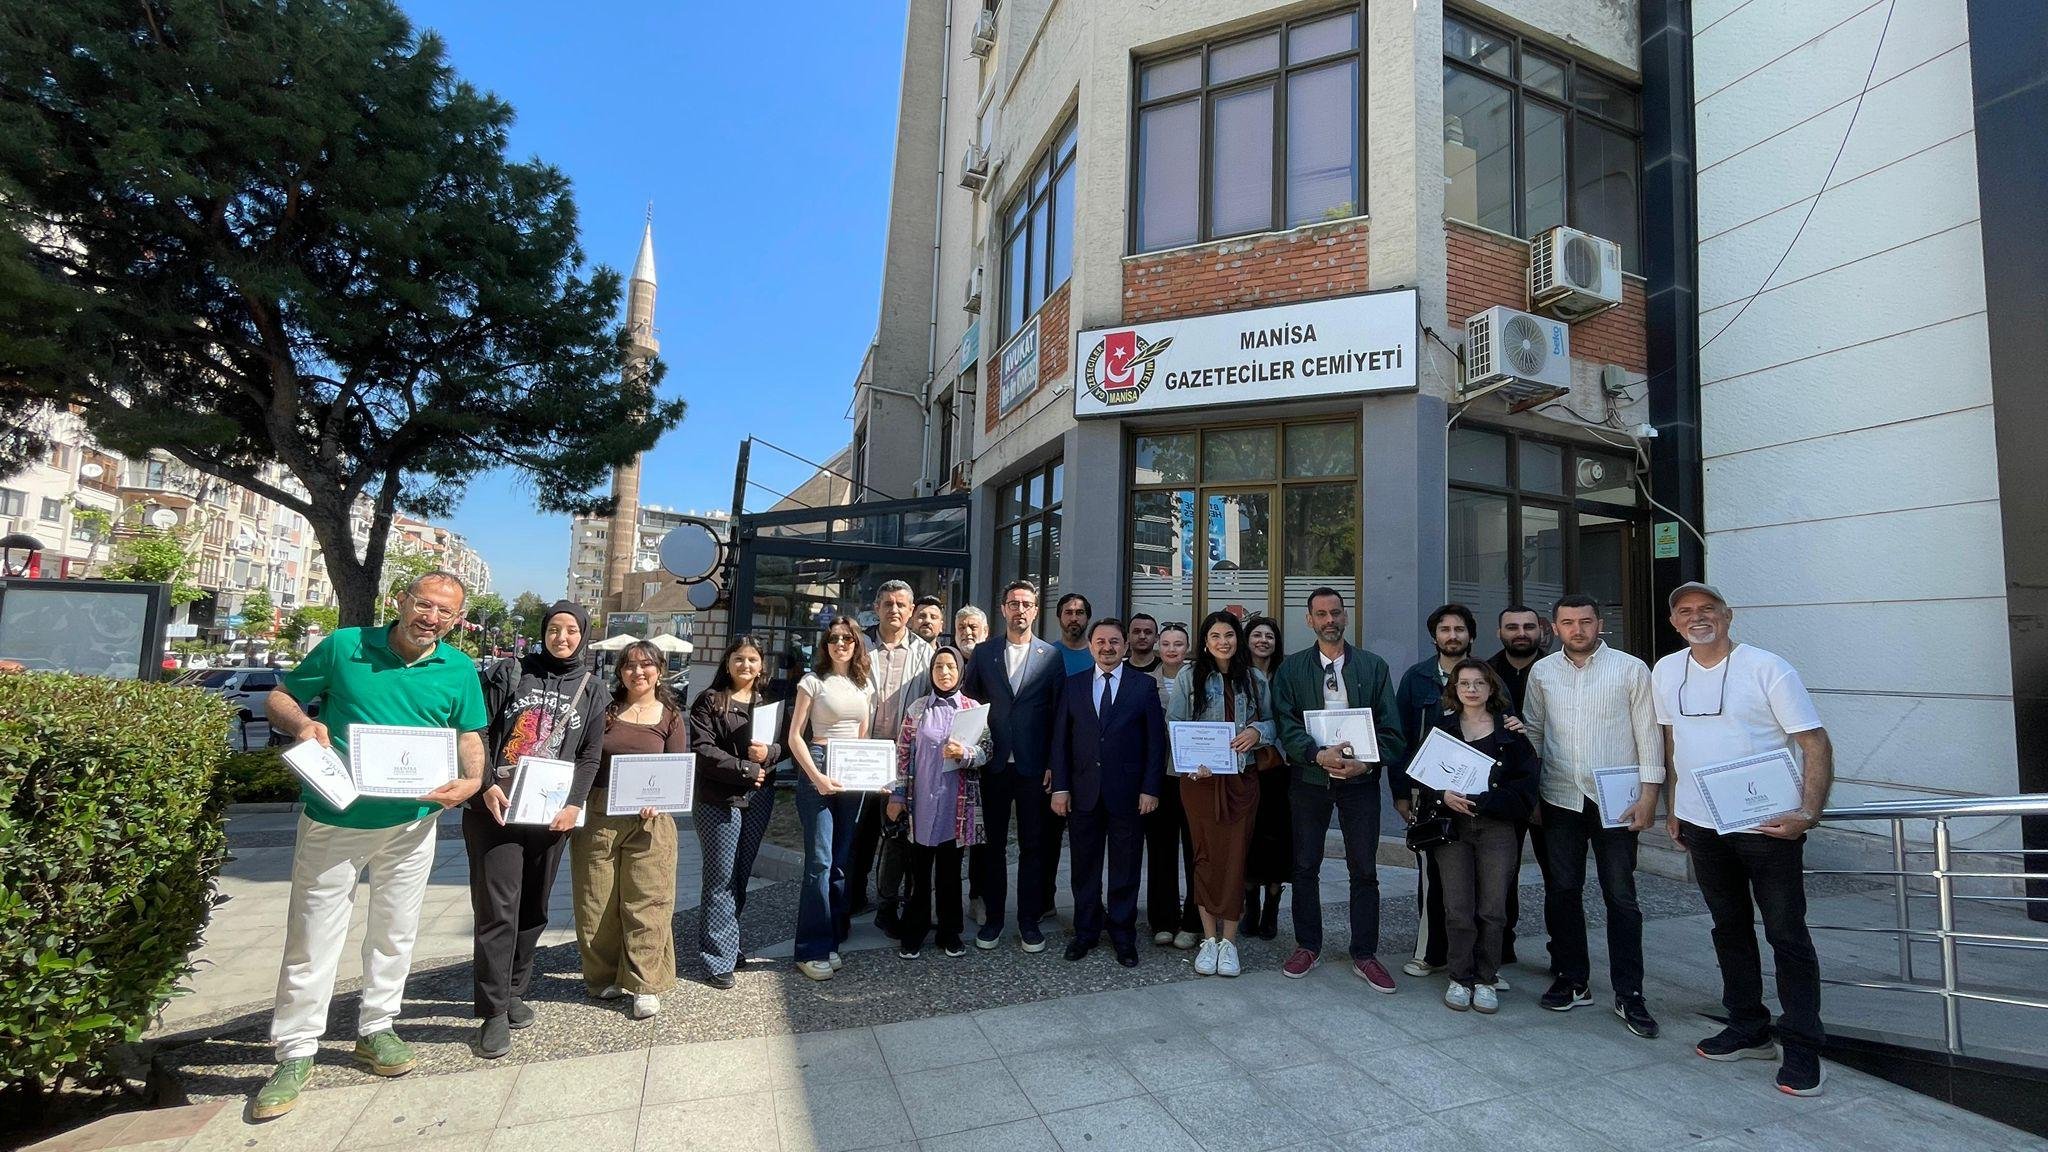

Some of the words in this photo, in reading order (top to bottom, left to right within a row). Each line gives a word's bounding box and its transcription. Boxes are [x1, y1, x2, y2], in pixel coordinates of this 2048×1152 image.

[1240, 322, 1317, 350] MANİSA
[1552, 326, 1561, 355] beko
[1005, 330, 1035, 375] AVUKAT
[1165, 359, 1295, 391] GAZETECİLER
[1301, 344, 1402, 377] CEMİYETİ
[1109, 389, 1138, 403] MANİSA
